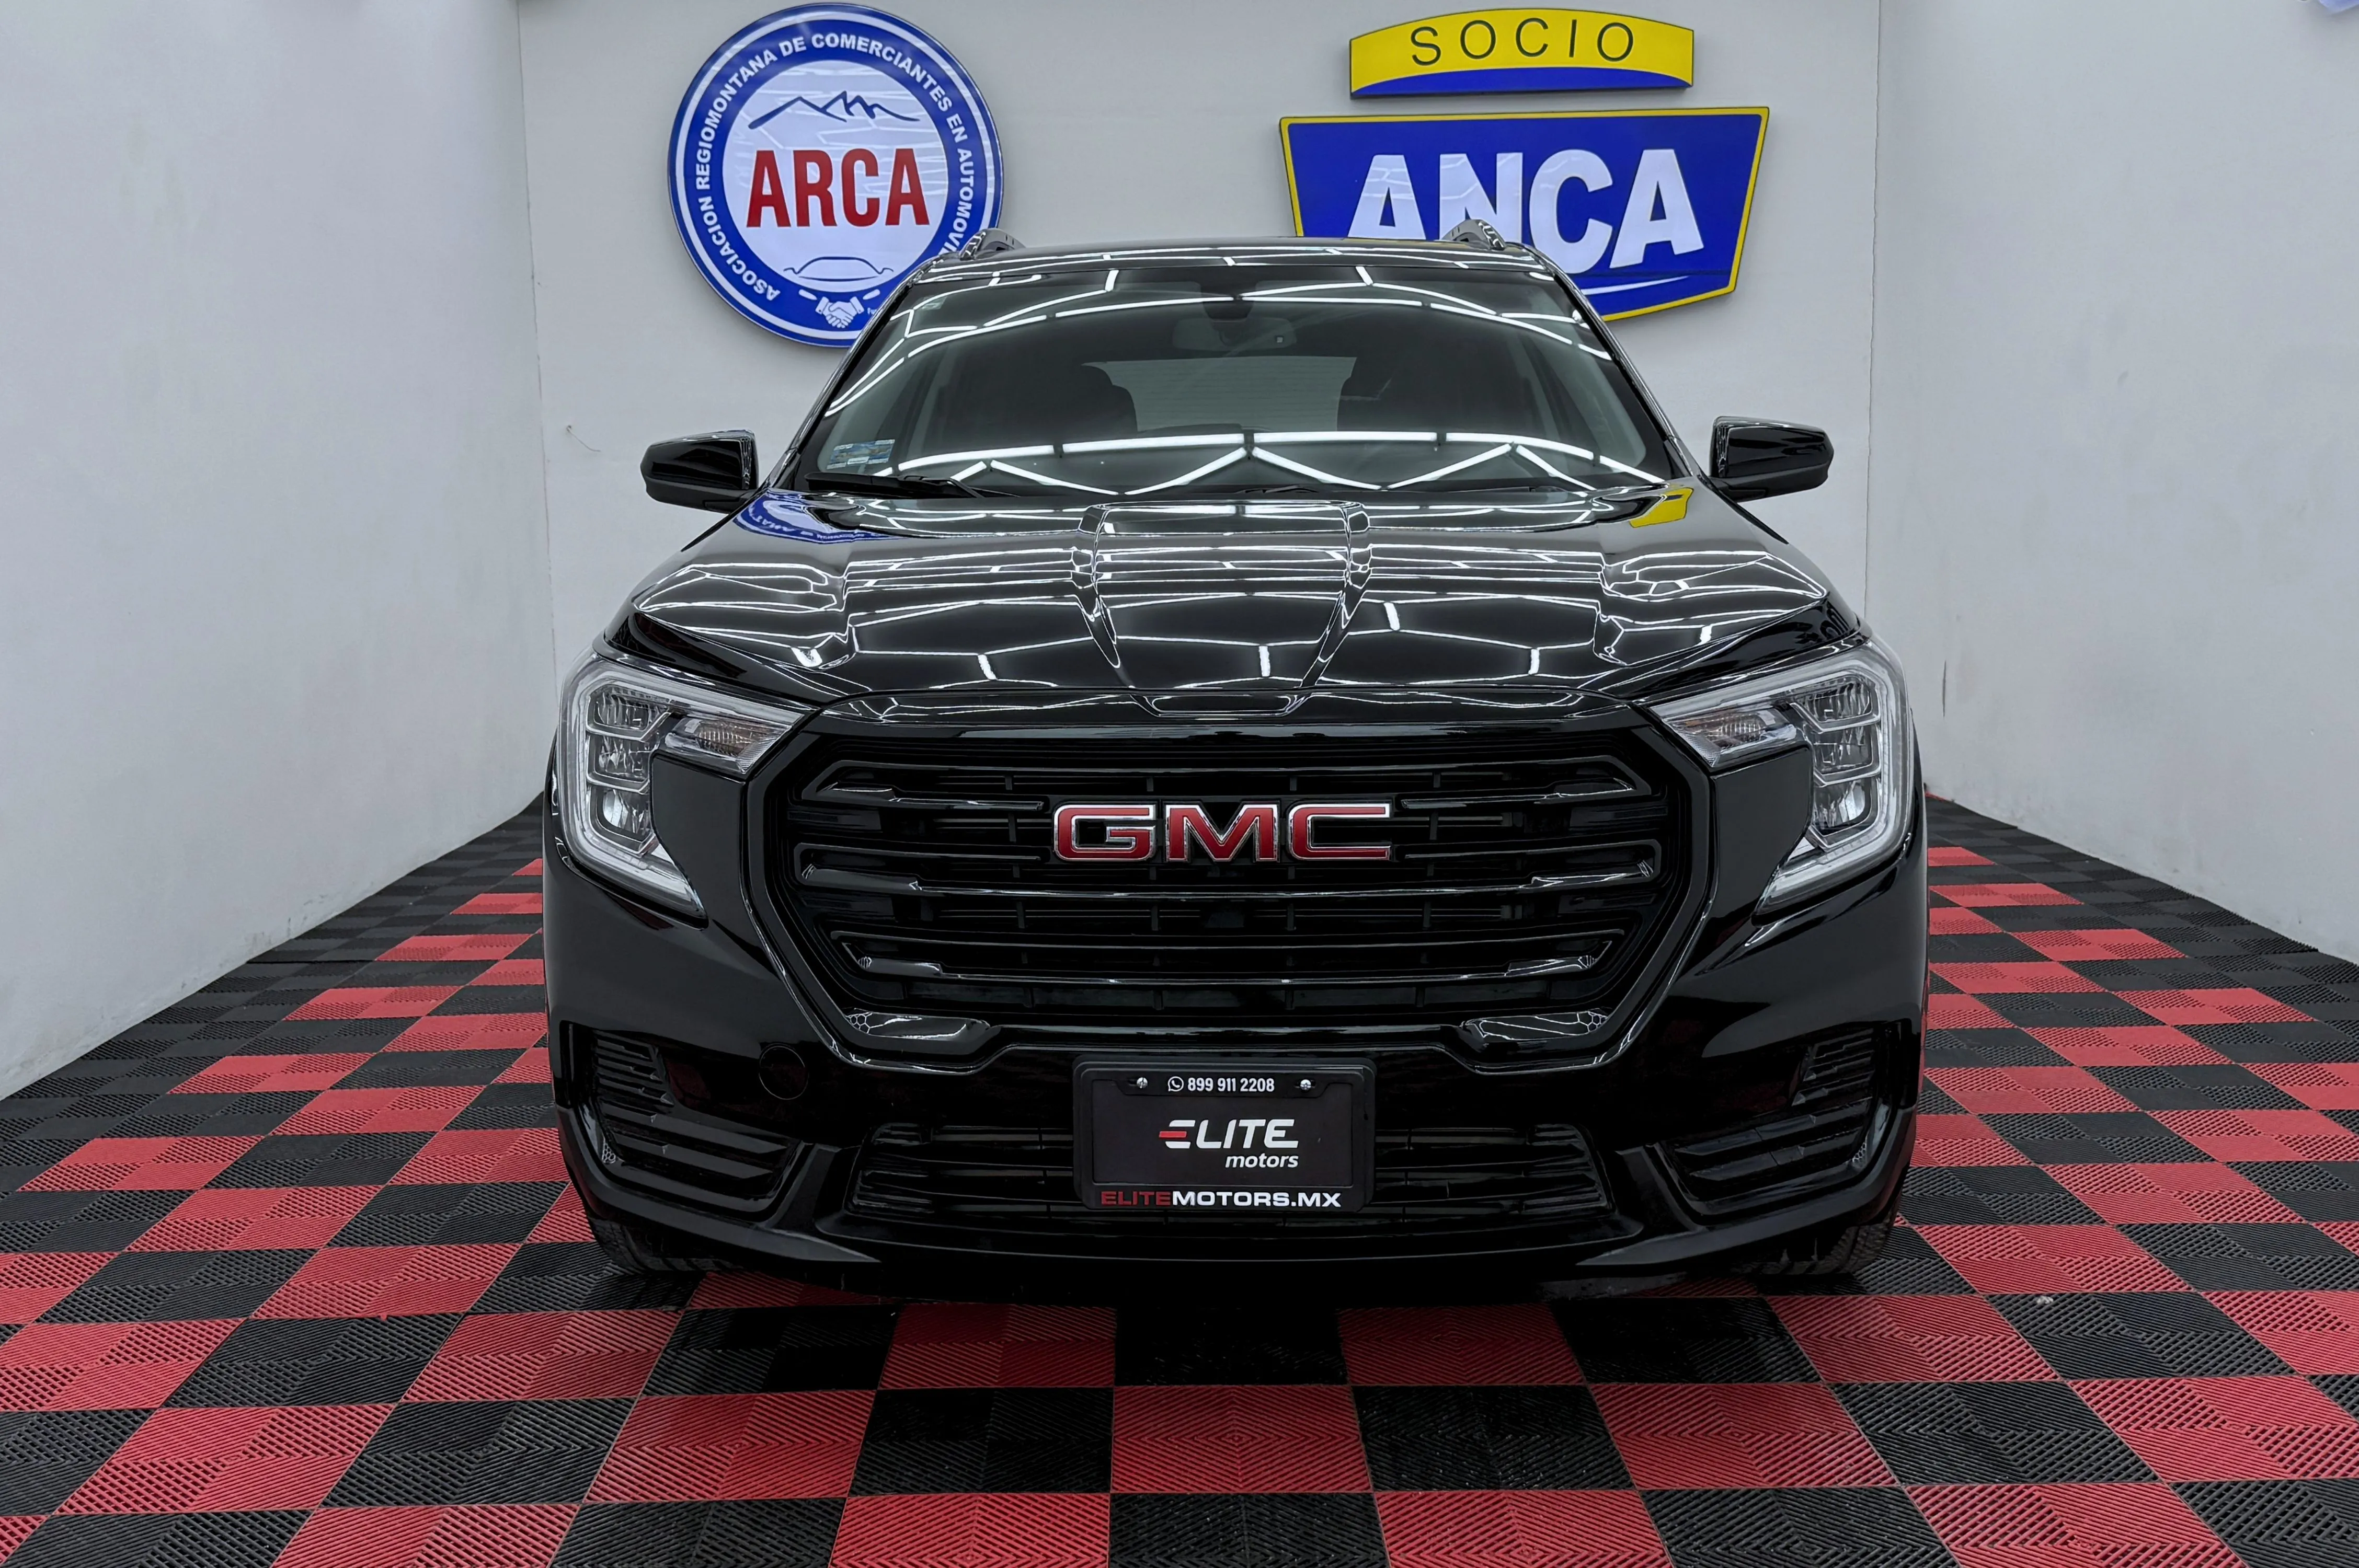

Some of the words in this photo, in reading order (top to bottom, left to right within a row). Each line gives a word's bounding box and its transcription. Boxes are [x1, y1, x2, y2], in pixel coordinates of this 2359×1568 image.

[778, 36, 806, 58] DE
[1411, 18, 1634, 66] SOCIO
[811, 32, 953, 112] COMERCIANTES
[695, 49, 777, 190] REGIOMONTANA
[947, 112, 967, 144] EN
[747, 148, 930, 228] ARCA
[1348, 149, 1703, 273] ANCA
[700, 195, 780, 301] ASOCIACION
[1053, 804, 1391, 862] GMC
[1187, 1077, 1213, 1091] 899
[1217, 1078, 1236, 1091] 911
[1240, 1078, 1274, 1092] 2208
[1159, 1119, 1299, 1149] ELITE
[1225, 1153, 1299, 1168] motors
[1101, 1191, 1341, 1207] ELITEMOTORS.MX
